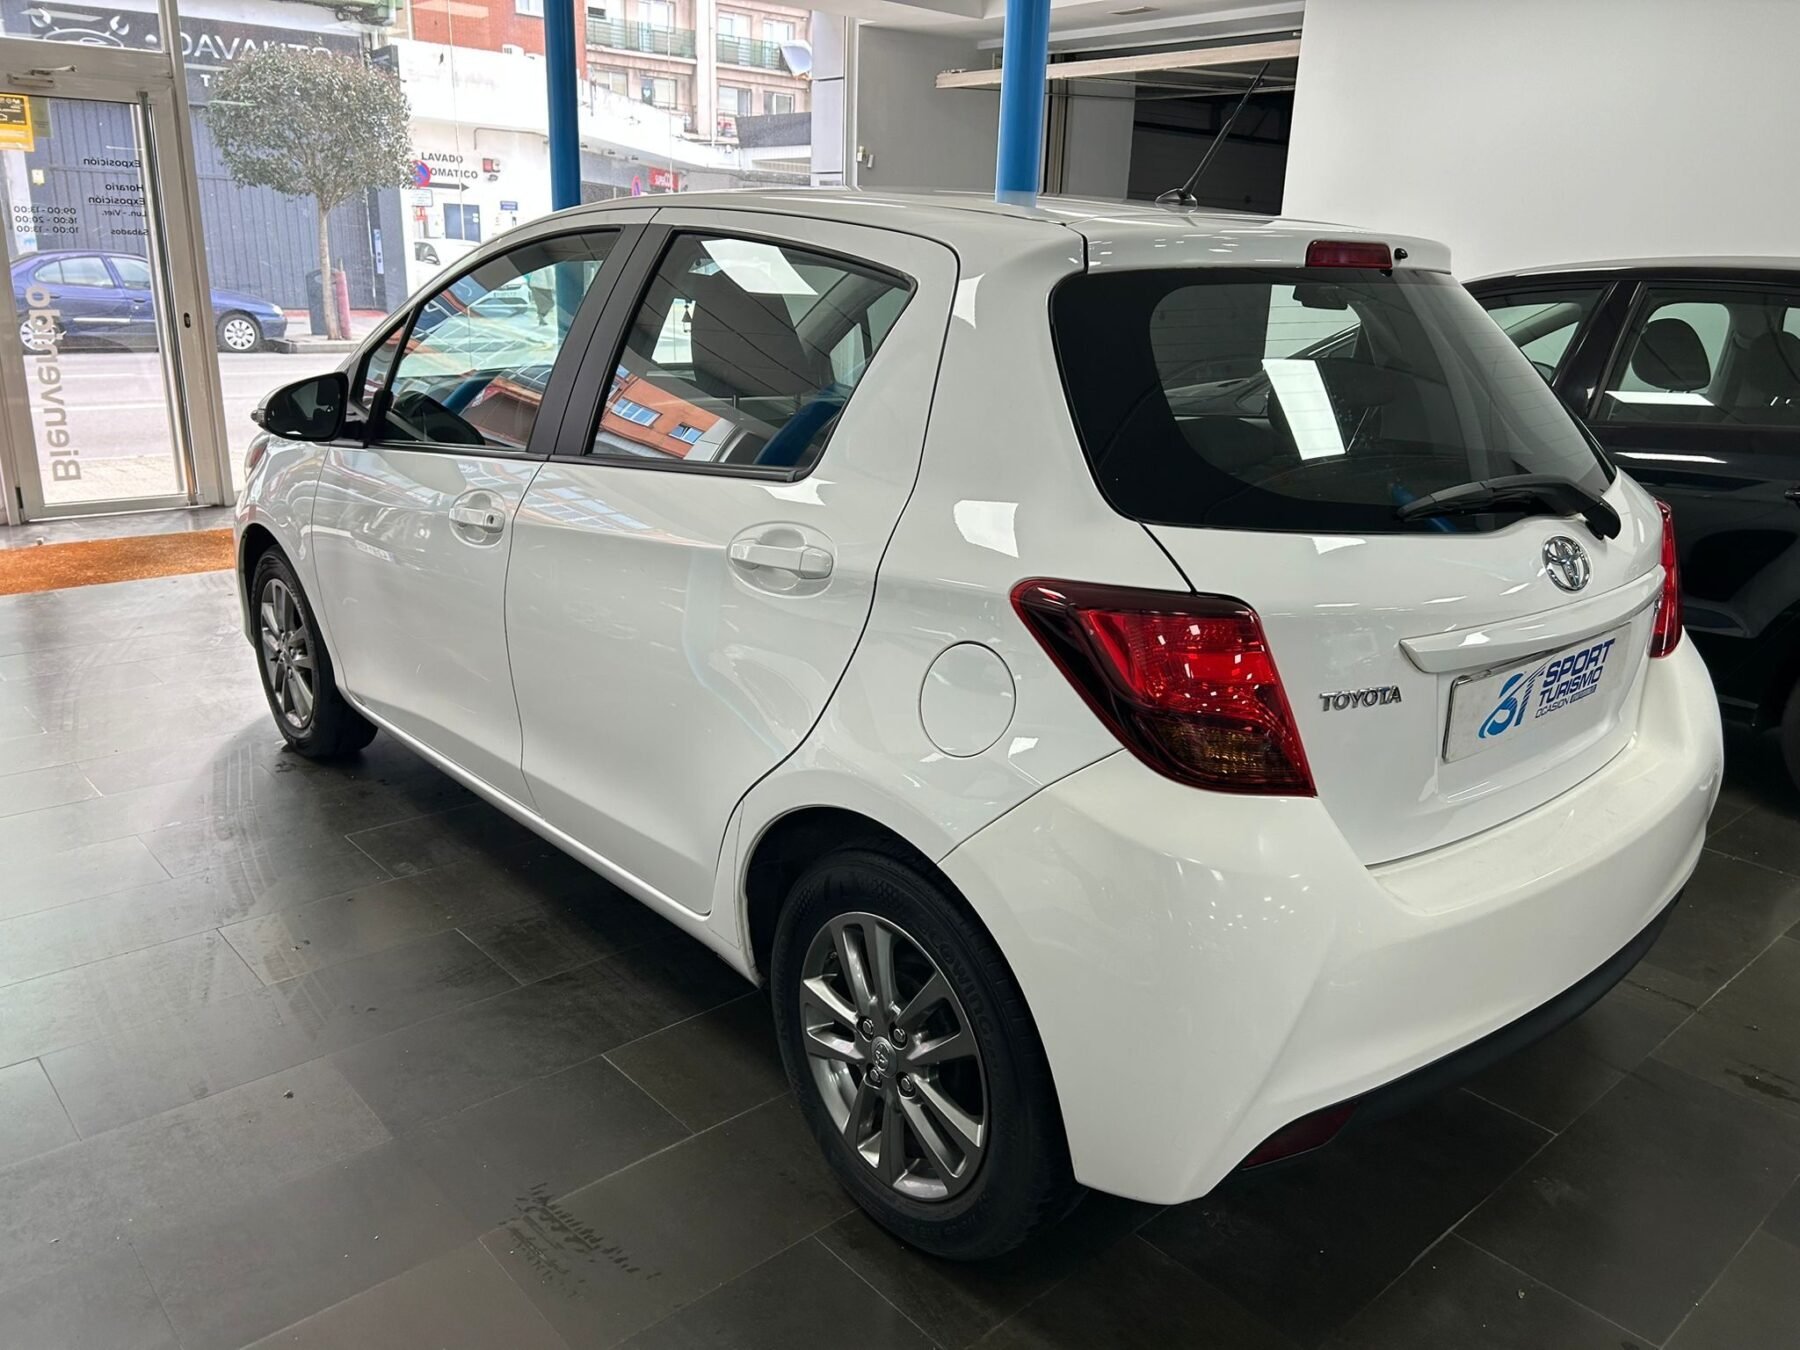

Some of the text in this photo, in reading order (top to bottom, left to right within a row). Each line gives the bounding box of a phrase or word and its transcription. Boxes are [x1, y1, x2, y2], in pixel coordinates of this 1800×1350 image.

[421, 152, 464, 164] LAVADO
[1542, 638, 1616, 688] SPORT
[1319, 685, 1402, 711] TOYOTA
[1538, 666, 1603, 707] TURISMO
[1534, 697, 1571, 719] OCASION
